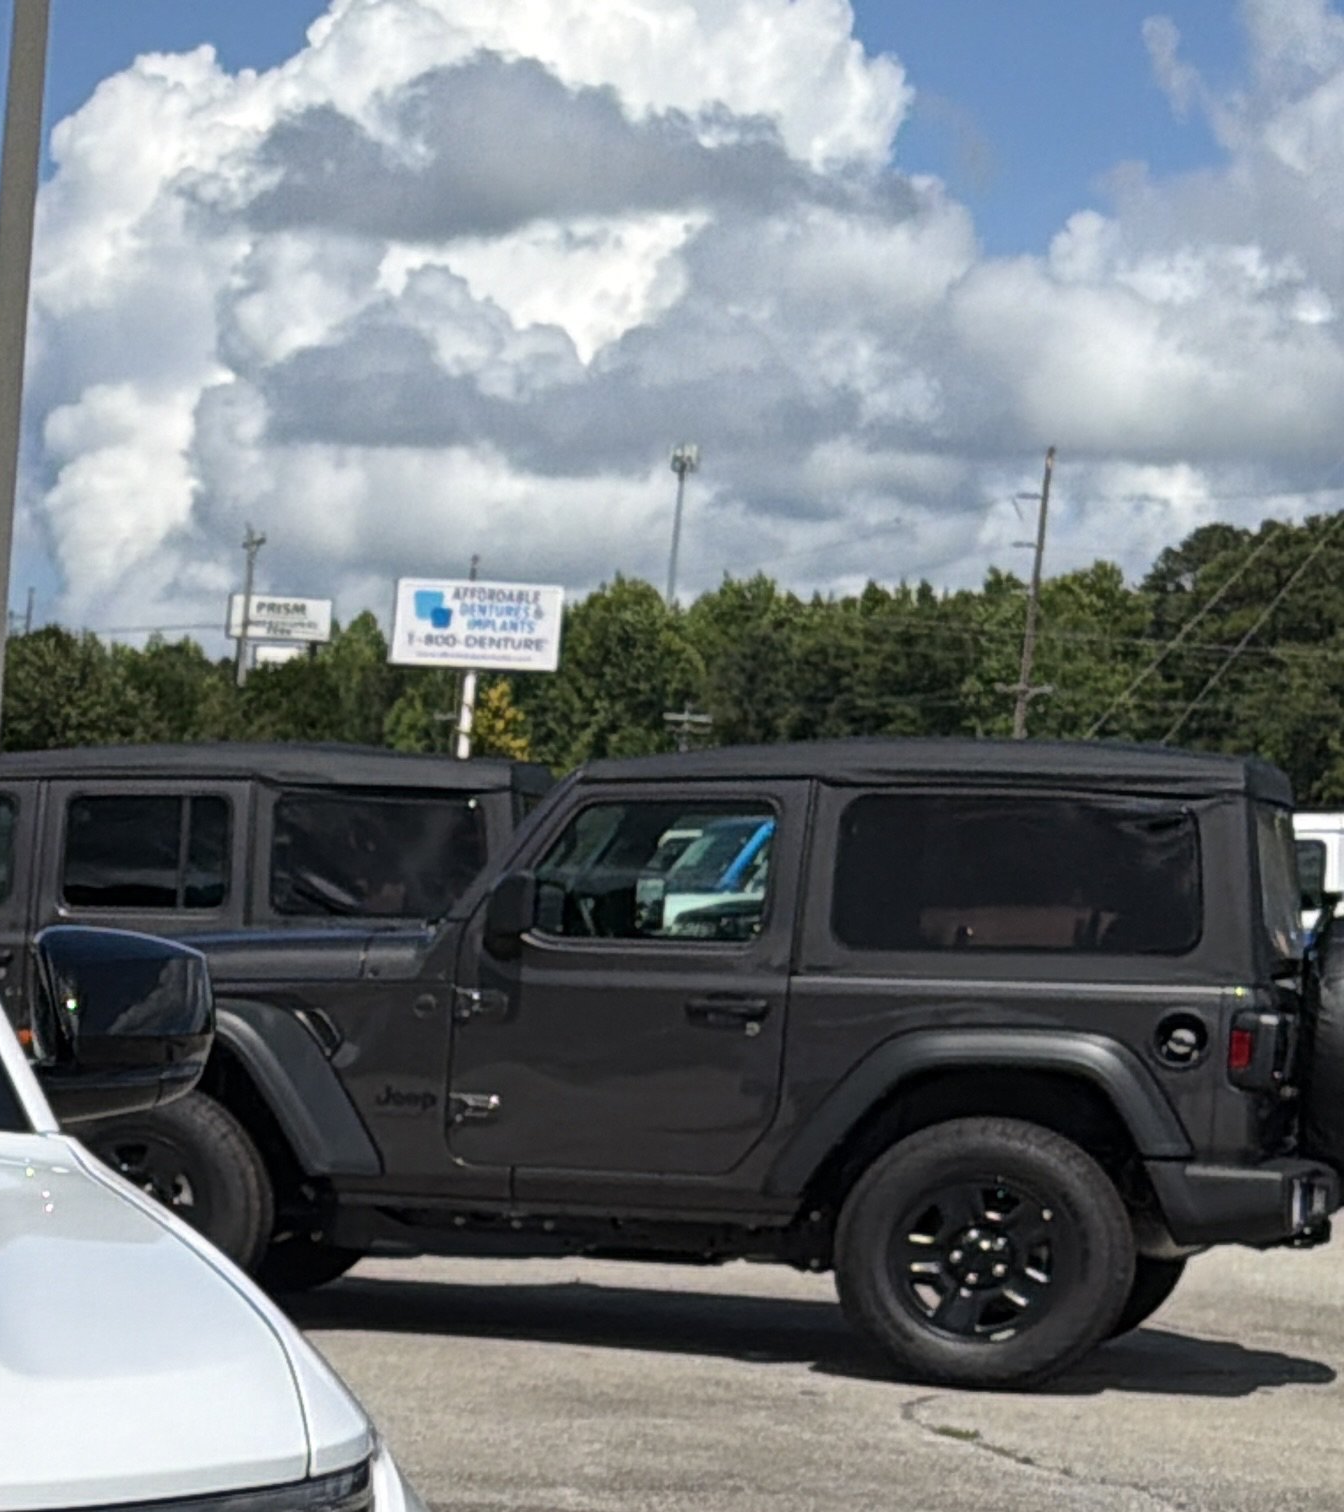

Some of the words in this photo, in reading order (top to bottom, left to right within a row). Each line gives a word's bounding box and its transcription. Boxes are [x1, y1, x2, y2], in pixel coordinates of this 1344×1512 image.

[452, 586, 541, 603] AFFORDABLE
[256, 601, 307, 616] PRISM
[459, 602, 530, 618] DENTURES
[467, 617, 535, 634] IMPLANTS
[374, 1084, 438, 1112] Jeep
